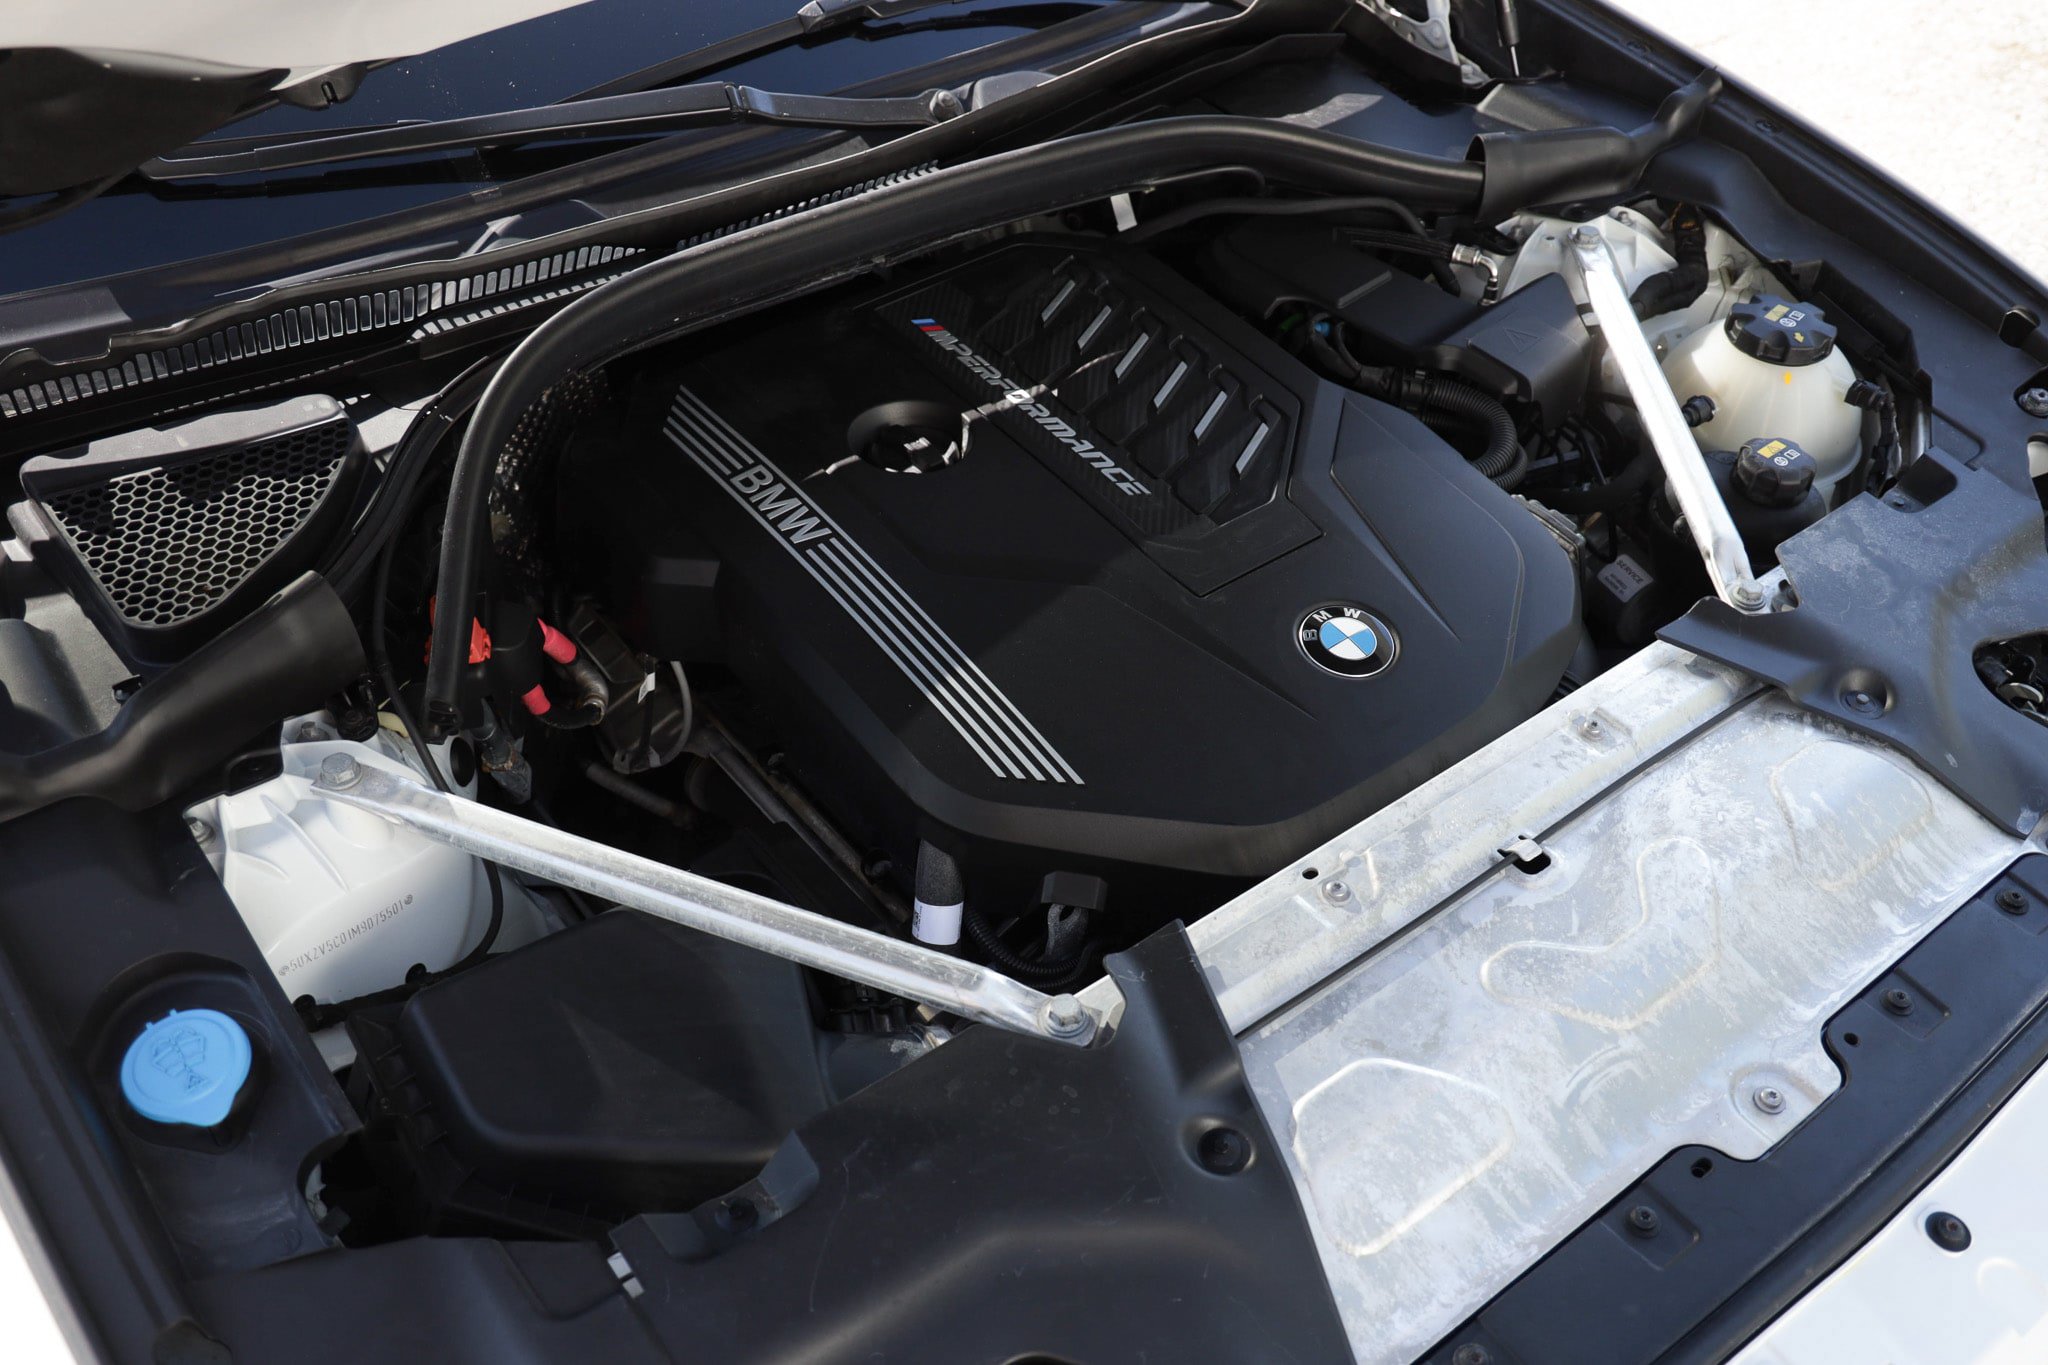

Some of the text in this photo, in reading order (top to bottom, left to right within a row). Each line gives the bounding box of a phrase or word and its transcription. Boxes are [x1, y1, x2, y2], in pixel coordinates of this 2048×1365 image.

[939, 343, 1152, 496] PERFORMANCE
[729, 463, 833, 545] BMW
[1302, 607, 1361, 642] BMW
